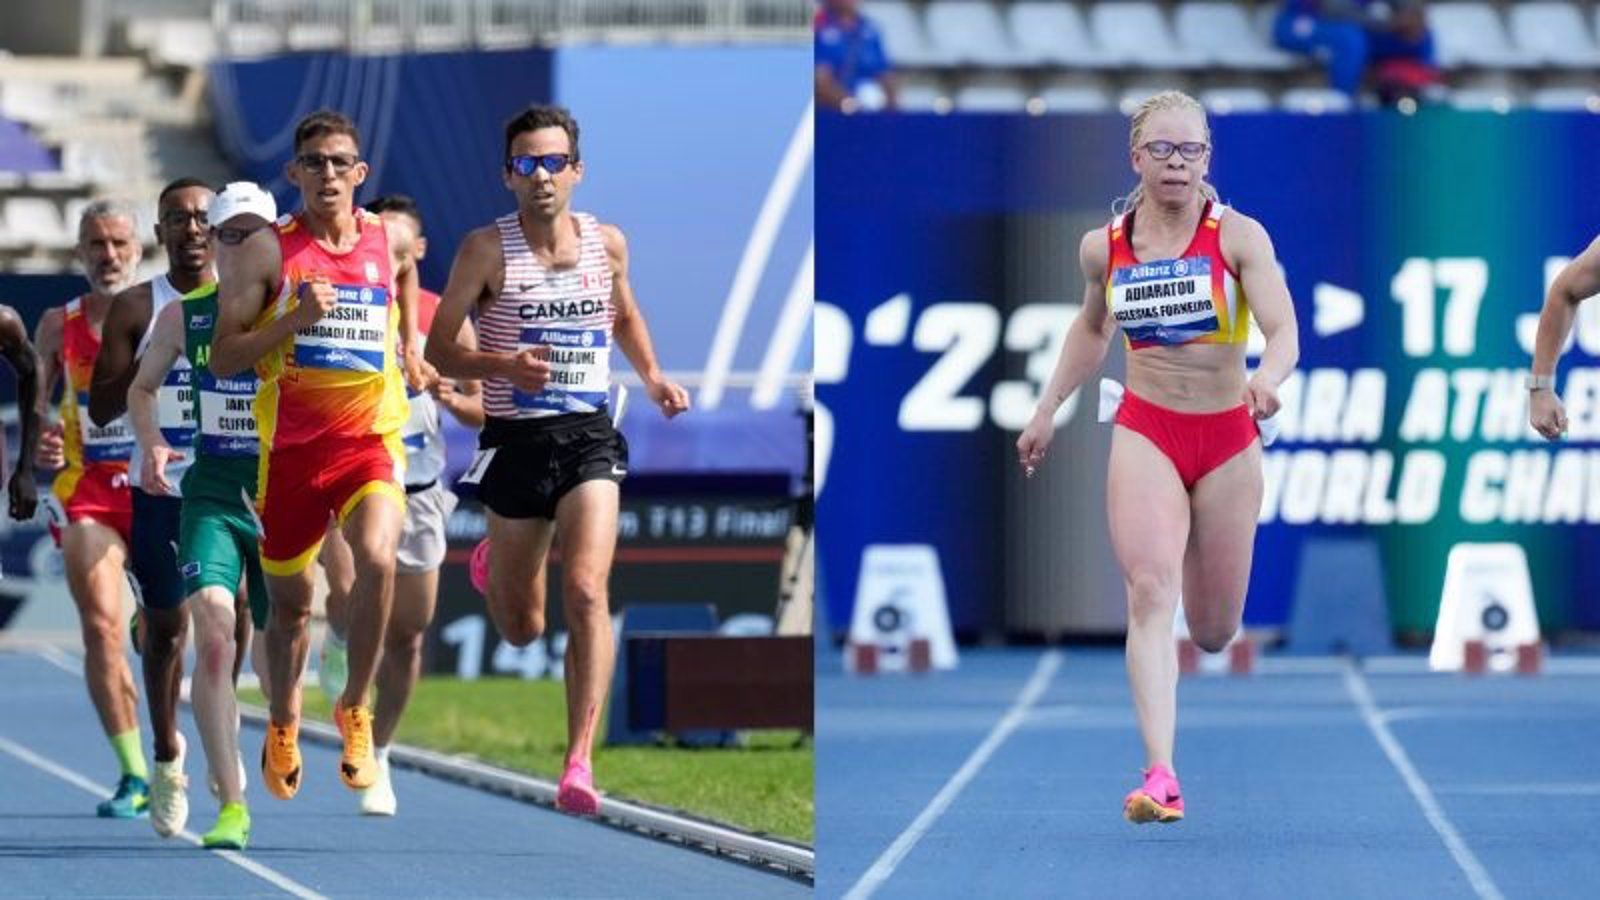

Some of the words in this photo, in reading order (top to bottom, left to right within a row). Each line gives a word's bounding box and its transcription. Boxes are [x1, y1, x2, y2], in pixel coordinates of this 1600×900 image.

[1130, 264, 1171, 280] Allianz
[1125, 280, 1195, 302] ADIARATOU
[519, 299, 605, 319] CANADA
[1391, 257, 1488, 357] 17
[540, 331, 580, 345] Allianz
[219, 417, 259, 431] CLIFFO
